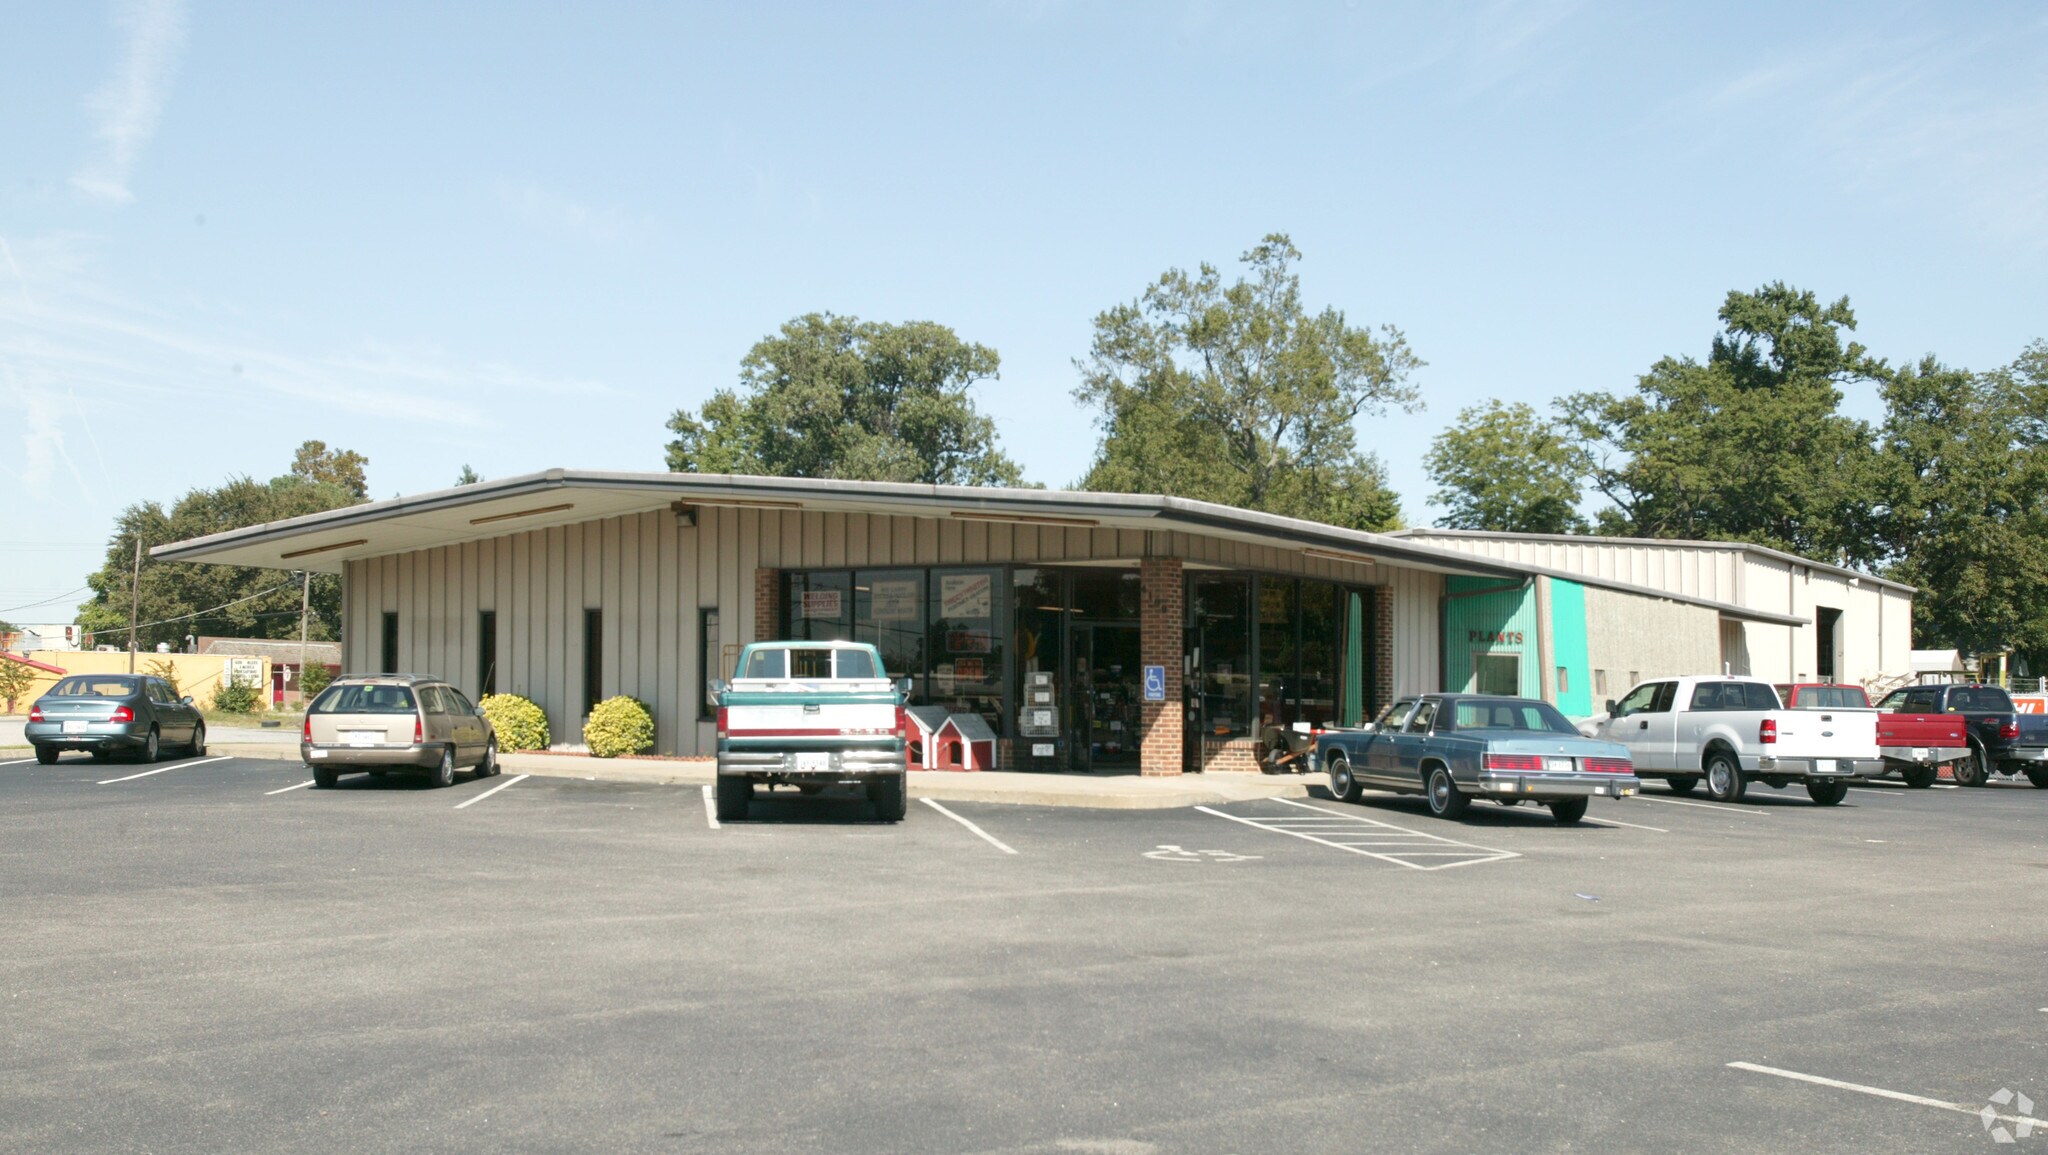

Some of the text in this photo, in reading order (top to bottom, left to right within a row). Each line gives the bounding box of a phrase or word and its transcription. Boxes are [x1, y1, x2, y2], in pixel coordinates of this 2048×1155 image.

[804, 592, 838, 600] WELDING
[804, 600, 838, 608] SUPPLIES
[1469, 630, 1524, 645] PLANTS
